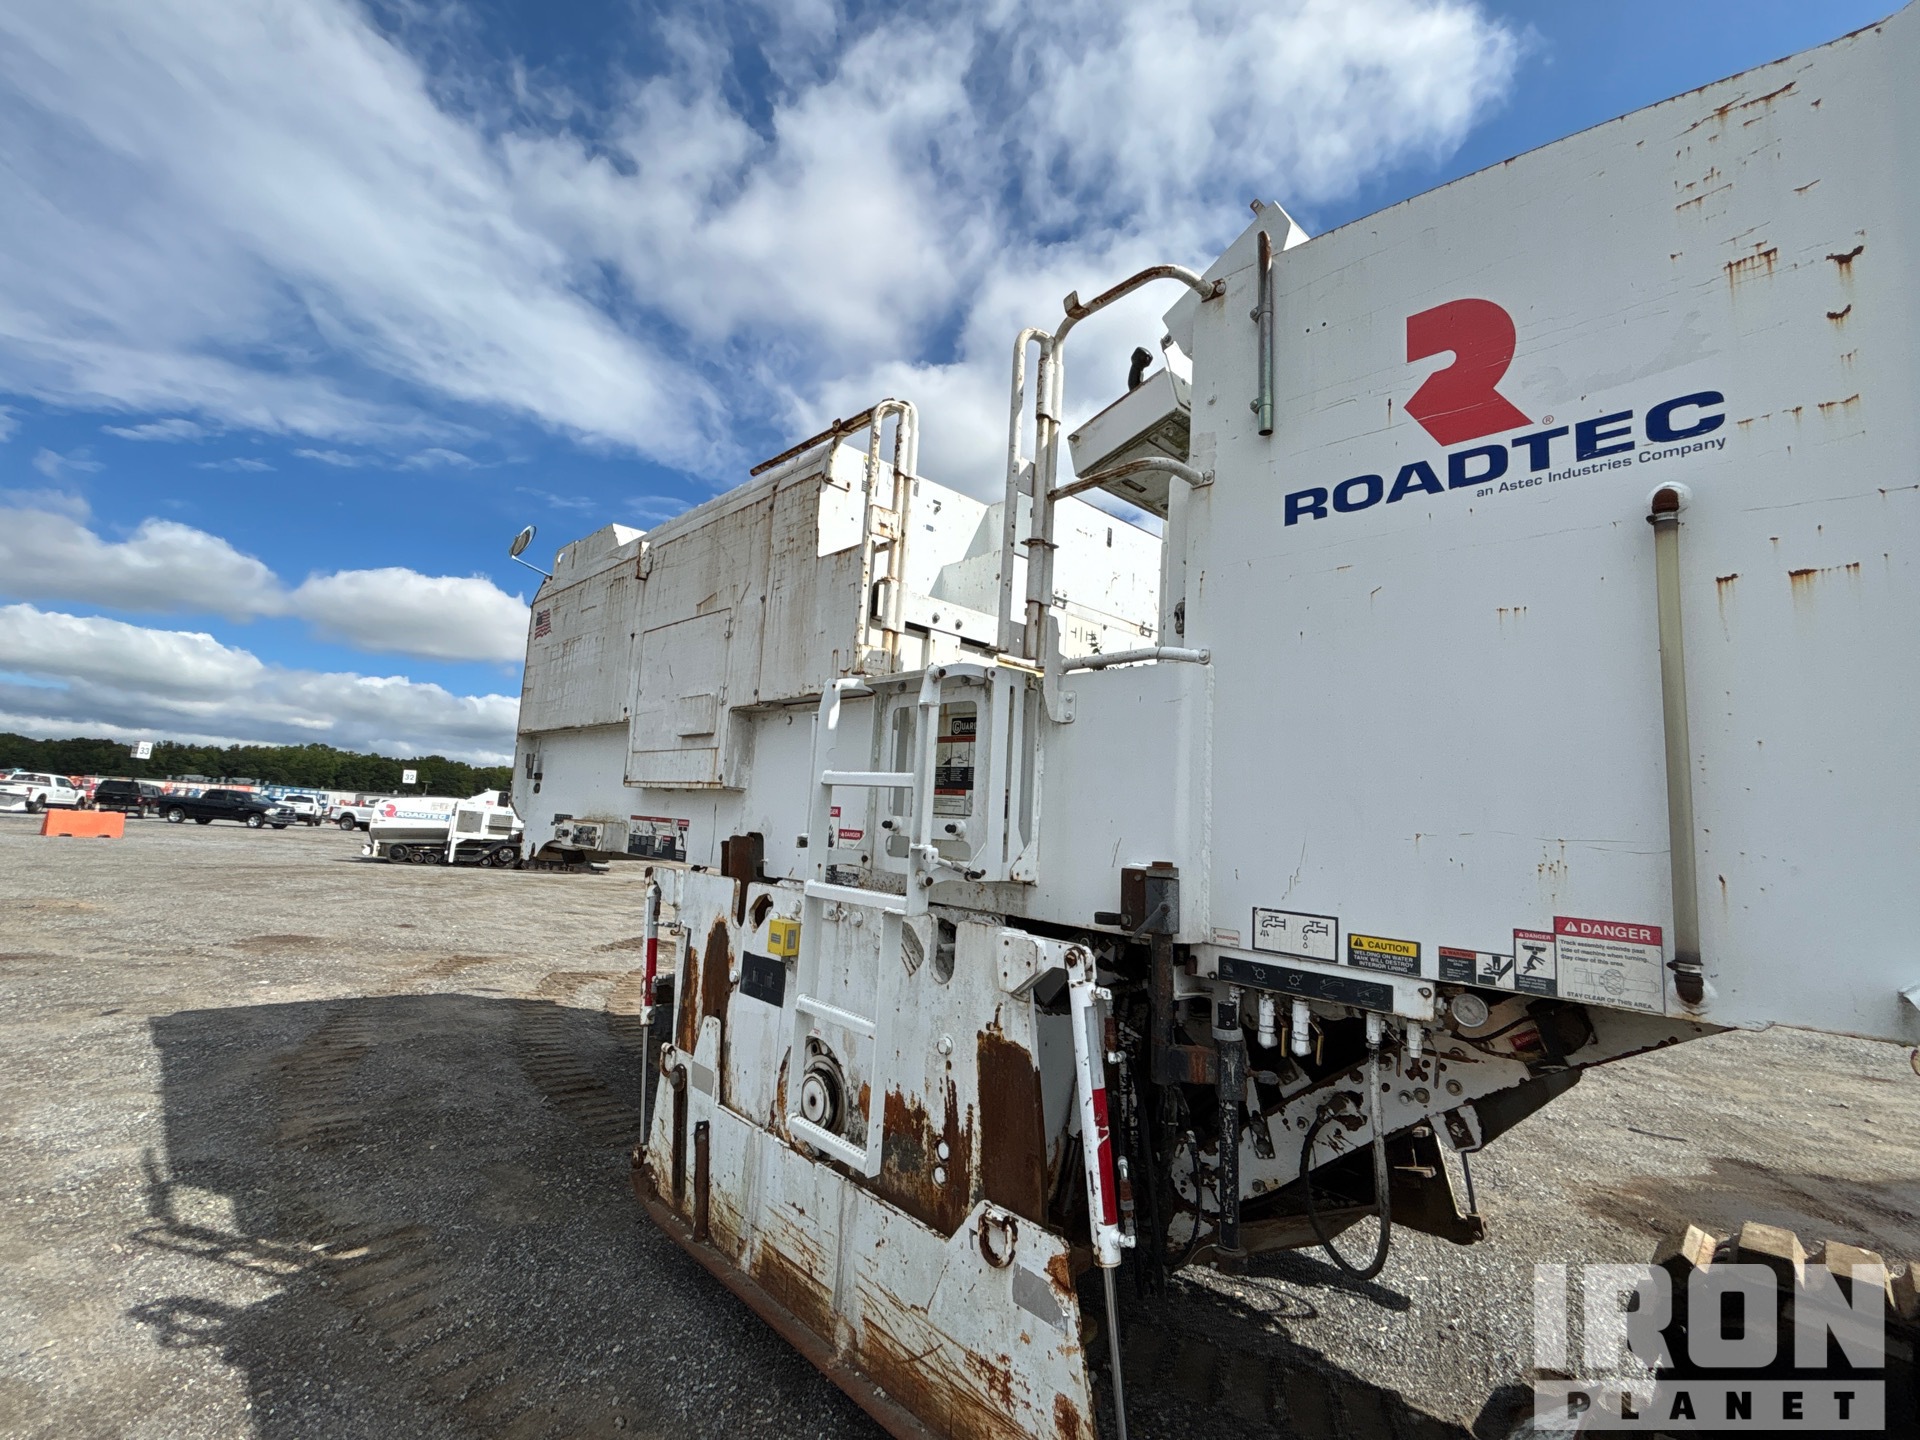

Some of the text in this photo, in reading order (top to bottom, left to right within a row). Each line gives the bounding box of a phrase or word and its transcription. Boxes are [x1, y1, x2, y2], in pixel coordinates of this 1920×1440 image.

[1284, 391, 1726, 527] ROADTEC
[1476, 436, 1727, 498] an Astec Industries Company
[140, 747, 150, 755] 33
[1524, 931, 1551, 940] DANGER
[1580, 922, 1651, 941] DANGER
[1367, 940, 1409, 953] CAUTION
[1577, 942, 1605, 950] assembly
[1606, 945, 1631, 953] extends
[1353, 950, 1381, 958] WELDING
[1392, 955, 1414, 963] WATER
[1580, 949, 1606, 957] machine
[1358, 961, 1408, 973] INTERIOR LINING
[1370, 956, 1384, 964] WILL
[1385, 959, 1414, 968] DESTROY
[1584, 993, 1606, 1001] CLEAR
